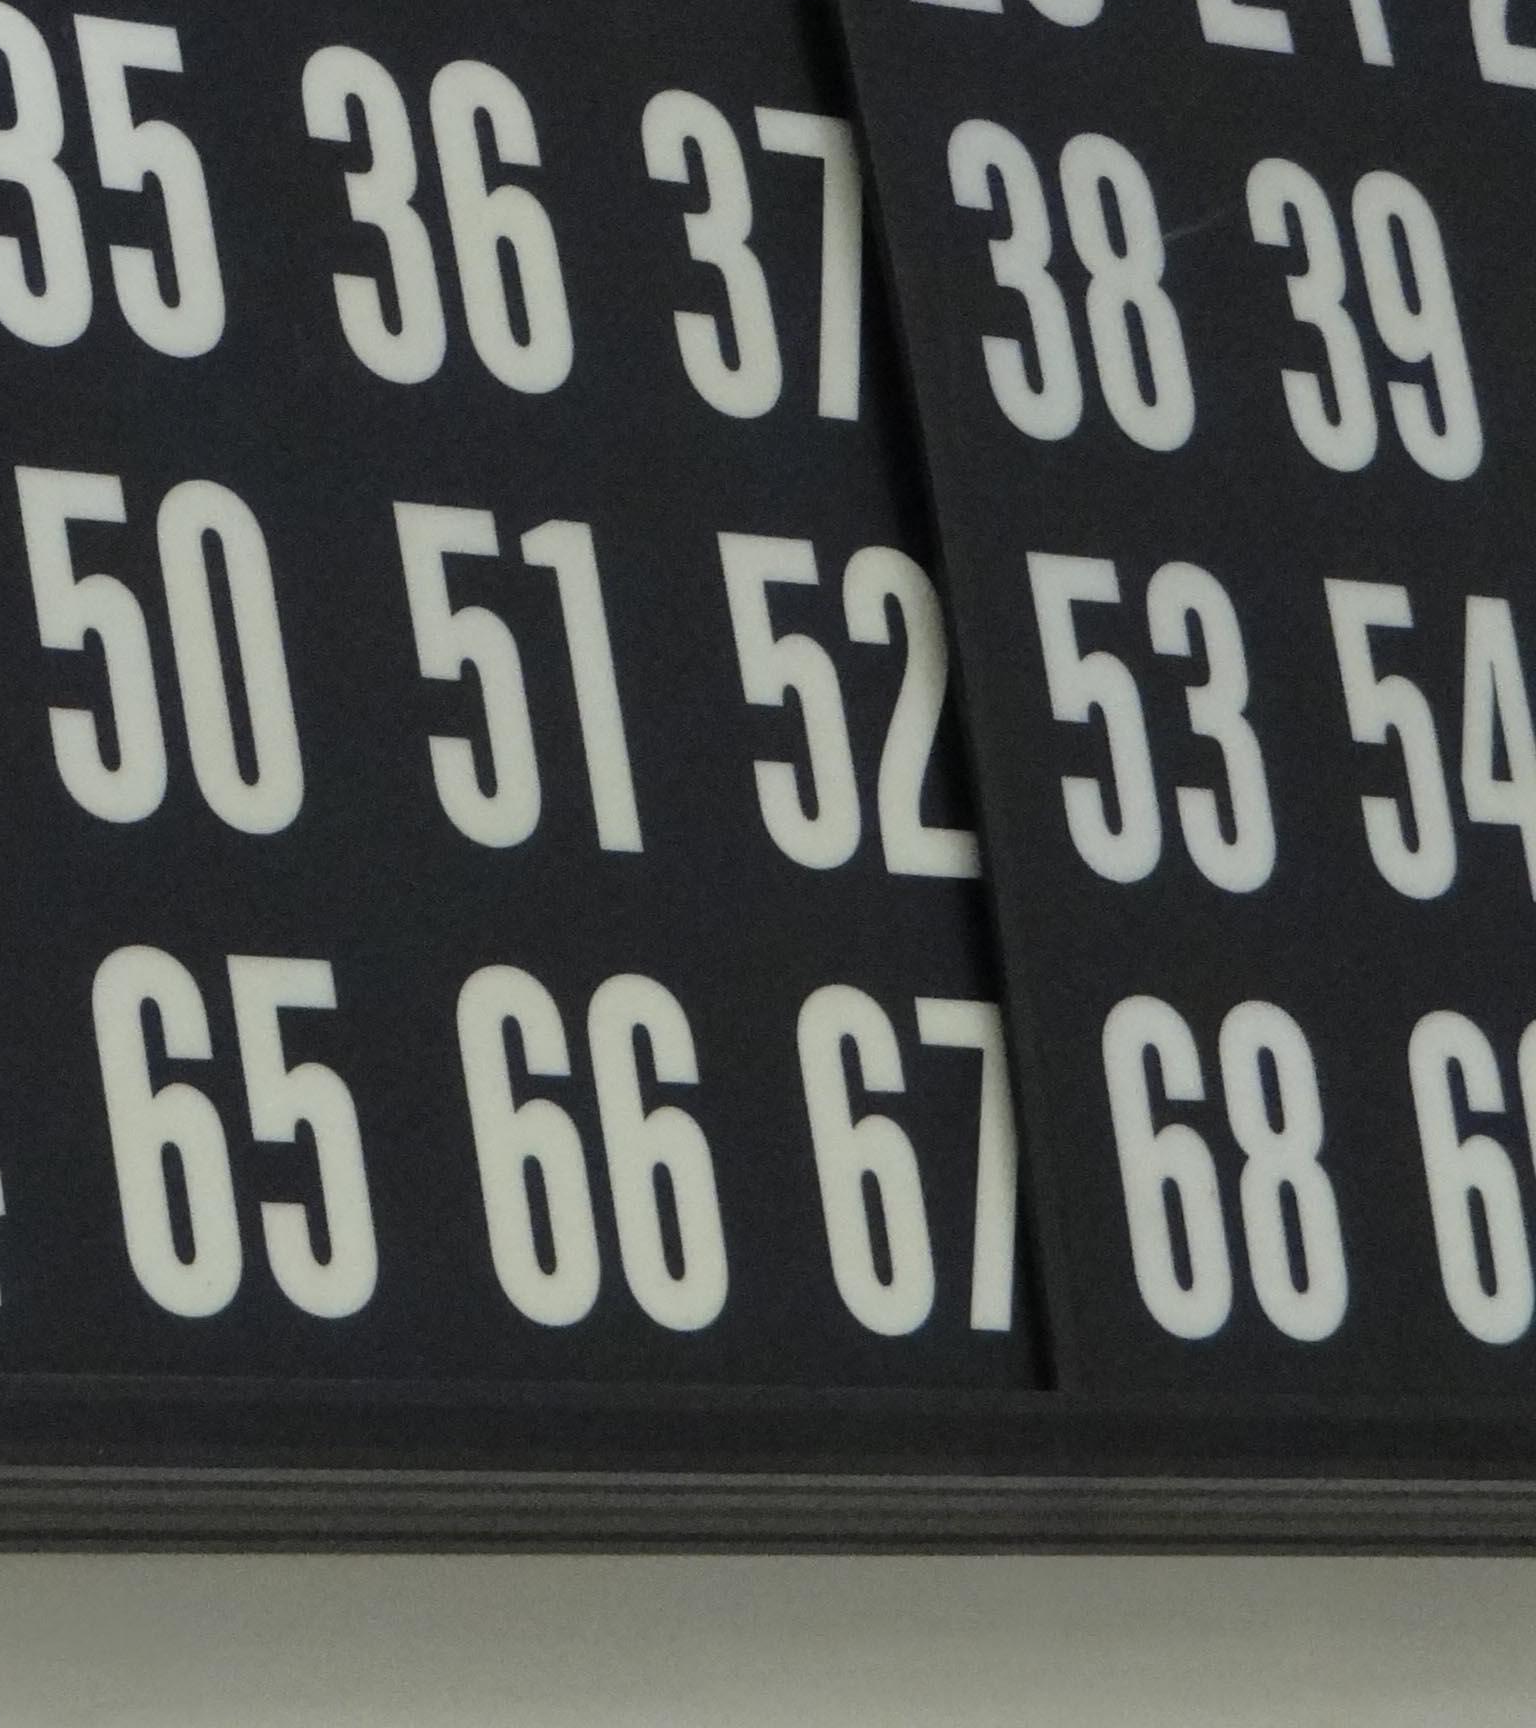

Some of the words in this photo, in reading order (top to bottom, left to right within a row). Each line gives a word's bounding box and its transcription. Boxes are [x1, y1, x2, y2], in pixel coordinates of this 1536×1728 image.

[302, 45, 574, 394] 36
[641, 90, 860, 420] 37
[948, 119, 1195, 451] 38
[1246, 158, 1483, 481] 39
[15, 466, 304, 834] 50
[393, 502, 643, 852] 51
[718, 532, 974, 877] 52
[1027, 552, 1276, 893] 53
[1324, 578, 1536, 901] 54
[92, 945, 378, 1319] 65
[456, 965, 728, 1331] 66
[797, 984, 1016, 1336] 67
[1102, 995, 1348, 1341] 68
[1408, 1010, 1536, 1344] 6
